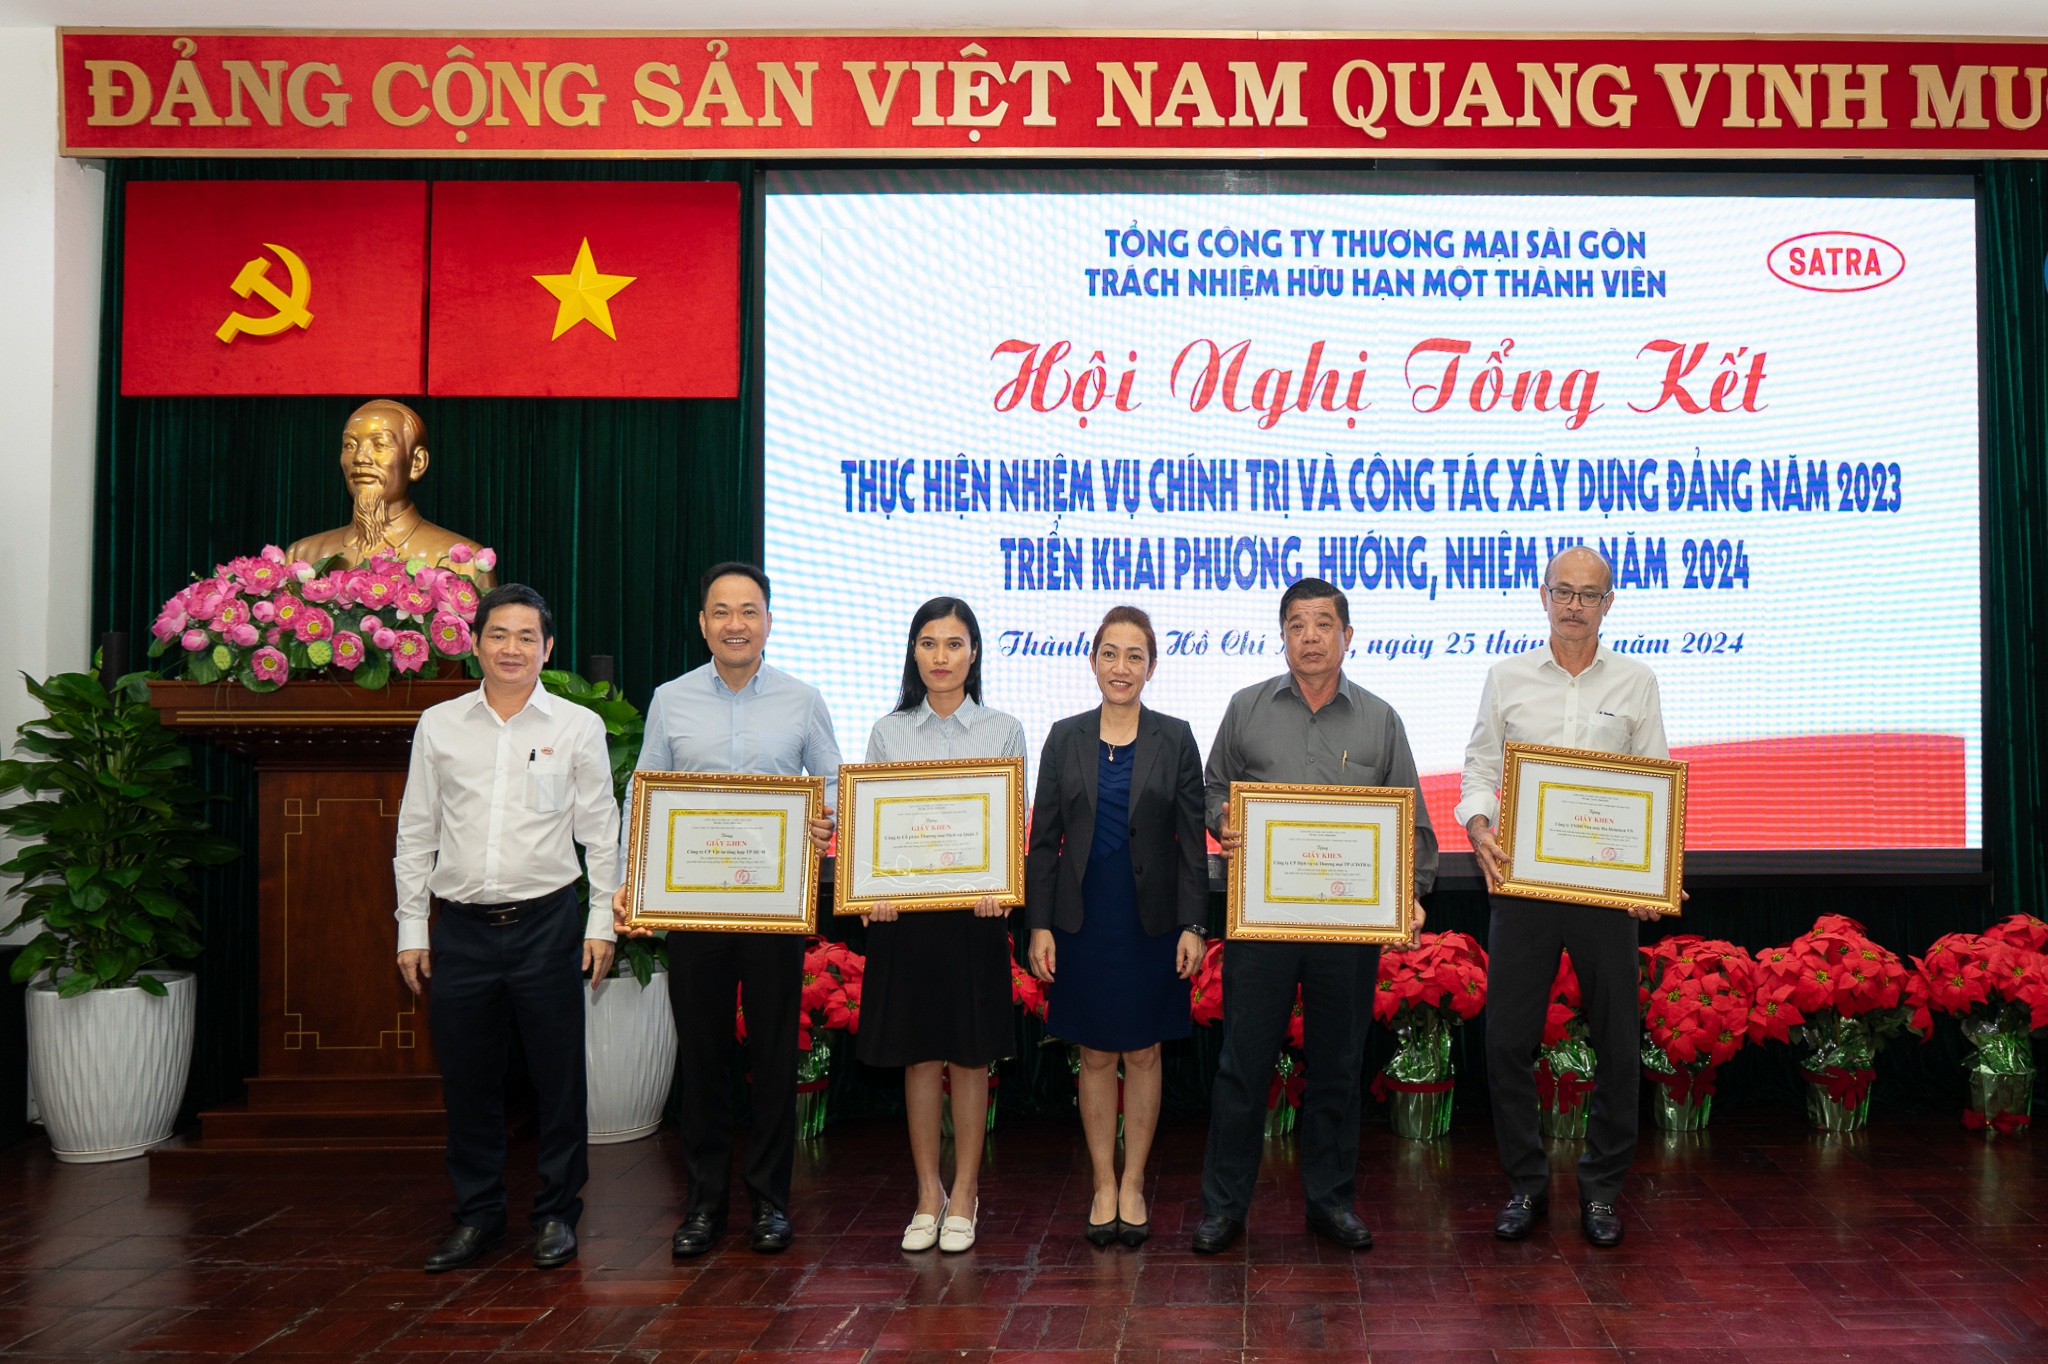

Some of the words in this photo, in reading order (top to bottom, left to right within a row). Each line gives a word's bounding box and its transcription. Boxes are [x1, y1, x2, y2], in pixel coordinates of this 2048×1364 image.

[84, 37, 352, 128] ĐẢNG
[372, 44, 608, 144] CỘNG
[631, 39, 819, 128] SẢN
[843, 42, 1072, 143] VIỆT
[1096, 60, 1309, 128] NAM
[1332, 59, 1638, 139] QUANG
[1655, 62, 1888, 129] VINH
[1909, 64, 2048, 130] MU
[1105, 219, 1188, 258] TỔNG
[1198, 226, 1282, 258] CÔNG
[1291, 230, 1325, 257] TY
[1332, 229, 1454, 258] THƯƠNG
[1463, 231, 1518, 262] MẠI
[1527, 227, 1570, 258] SÀI
[1579, 228, 1646, 259] GÒN
[1085, 265, 1178, 297] TRÁCH
[1189, 265, 1279, 300] NHIỆM
[1288, 265, 1343, 297] HỮU
[1353, 269, 1414, 300] HẠN
[1423, 266, 1488, 301] MỘT
[1495, 266, 1593, 297] THÀNH
[1601, 267, 1666, 298] VIÊN
[1789, 248, 1883, 277] SATRA
[991, 339, 1140, 428] Hội
[1171, 339, 1371, 430] Nghị
[1405, 338, 1604, 430] Tổng
[1628, 339, 1769, 414] Kết
[841, 458, 915, 520] THỰC
[924, 453, 991, 520] HIỆN
[1000, 453, 1094, 520] NHIỆM
[1102, 459, 1140, 520] VỤ
[1149, 454, 1238, 513] CHÍNH
[1246, 459, 1290, 519] TRỊ
[1297, 452, 1341, 512] VÀ
[1348, 452, 1435, 512] CÔNG
[1443, 453, 1499, 512] TÁC
[1507, 452, 1570, 512] XÂY
[1579, 458, 1659, 519] DỤNG
[1667, 446, 1753, 512] ĐẢNG
[1761, 455, 1830, 512] NĂM
[1837, 462, 1902, 514] 2023
[1000, 520, 1082, 590] TRIỂN
[1092, 538, 1166, 590] KHAI
[1173, 535, 1303, 591] PHƯƠNG
[1319, 530, 1438, 600] HƯỚNG,
[1446, 530, 1539, 596] NHIỆM
[1599, 531, 1669, 589] NĂM
[1682, 539, 1750, 589] 2024
[999, 630, 1091, 657] Thành
[1166, 630, 1209, 656] Hồ
[1221, 631, 1266, 656] Chí
[1367, 634, 1435, 660] ngày
[1444, 632, 1476, 654] 25
[1612, 634, 1670, 654] năm
[1680, 632, 1744, 654] 2024
[1302, 850, 1320, 858] GIẤY
